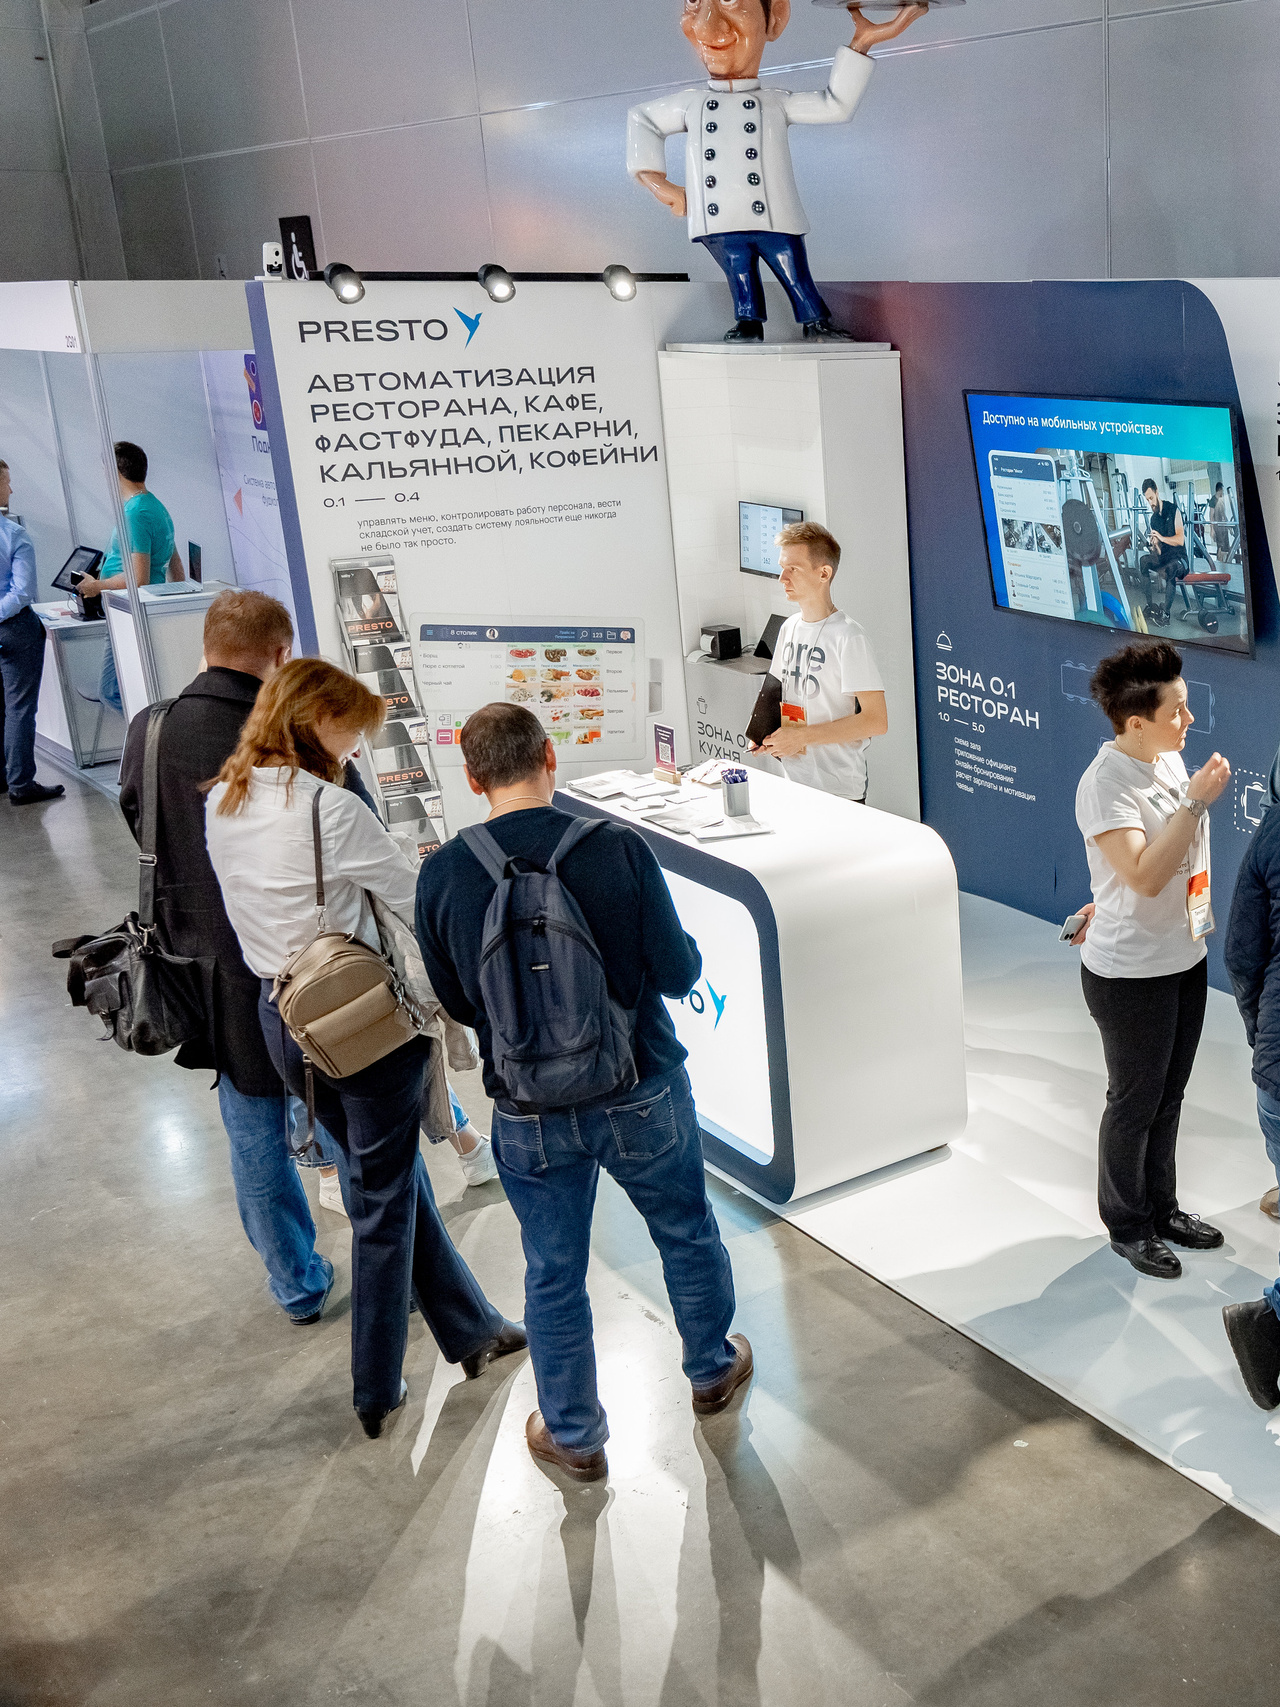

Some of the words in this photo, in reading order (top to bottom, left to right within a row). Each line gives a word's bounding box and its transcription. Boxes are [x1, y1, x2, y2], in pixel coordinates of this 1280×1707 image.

[298, 319, 448, 343] PRESTO
[307, 366, 595, 394] АВТОМАТИЗАЦИЯ
[310, 397, 518, 423] РЕСТОРАНА,
[524, 393, 603, 414] КАФЕ,
[982, 410, 1025, 428] Доступно
[1027, 416, 1039, 427] на
[1041, 415, 1097, 431] мобильных
[1099, 420, 1164, 436] устройствах
[315, 427, 492, 453] ФАСТФУДА,
[499, 419, 638, 443] ПЕКАРНИ,
[319, 449, 523, 483] КАЛЬЯННОЙ,
[529, 443, 658, 470] КОФЕЙНИ
[323, 497, 346, 508] 0.1
[394, 491, 420, 503] 0.4
[357, 517, 407, 529] управлять
[409, 514, 439, 523] меню,
[440, 508, 514, 521] контролировать
[516, 505, 546, 516] работу
[548, 501, 595, 513] персонала,
[597, 500, 621, 508] вести
[359, 527, 409, 539] складской
[411, 526, 434, 537] учет,
[436, 524, 473, 533] создать
[475, 519, 512, 530] систему
[515, 516, 563, 526] лояльности
[565, 514, 582, 522] еще
[584, 511, 617, 520] никогда
[375, 541, 400, 551] было
[420, 537, 457, 547] просто.
[348, 621, 393, 633] PRESTO
[936, 661, 986, 692] ЗОНА
[989, 676, 1016, 700] 0.1
[386, 696, 409, 706] STO
[937, 685, 1040, 729] РЕСТОРАН
[697, 721, 734, 745] ЗОНА
[972, 722, 985, 733] 5.0
[699, 740, 741, 763] КУХНЯ
[954, 736, 969, 747] схема
[970, 742, 981, 752] зала
[954, 748, 985, 764] приложение
[985, 758, 1017, 773] официанта
[955, 759, 1014, 784] онлайн-бронирование
[379, 771, 424, 783] PRESTO
[955, 770, 972, 781] расчет
[973, 777, 998, 790] зарплаты
[1004, 787, 1036, 801] мотивация
[418, 844, 440, 854] STO
